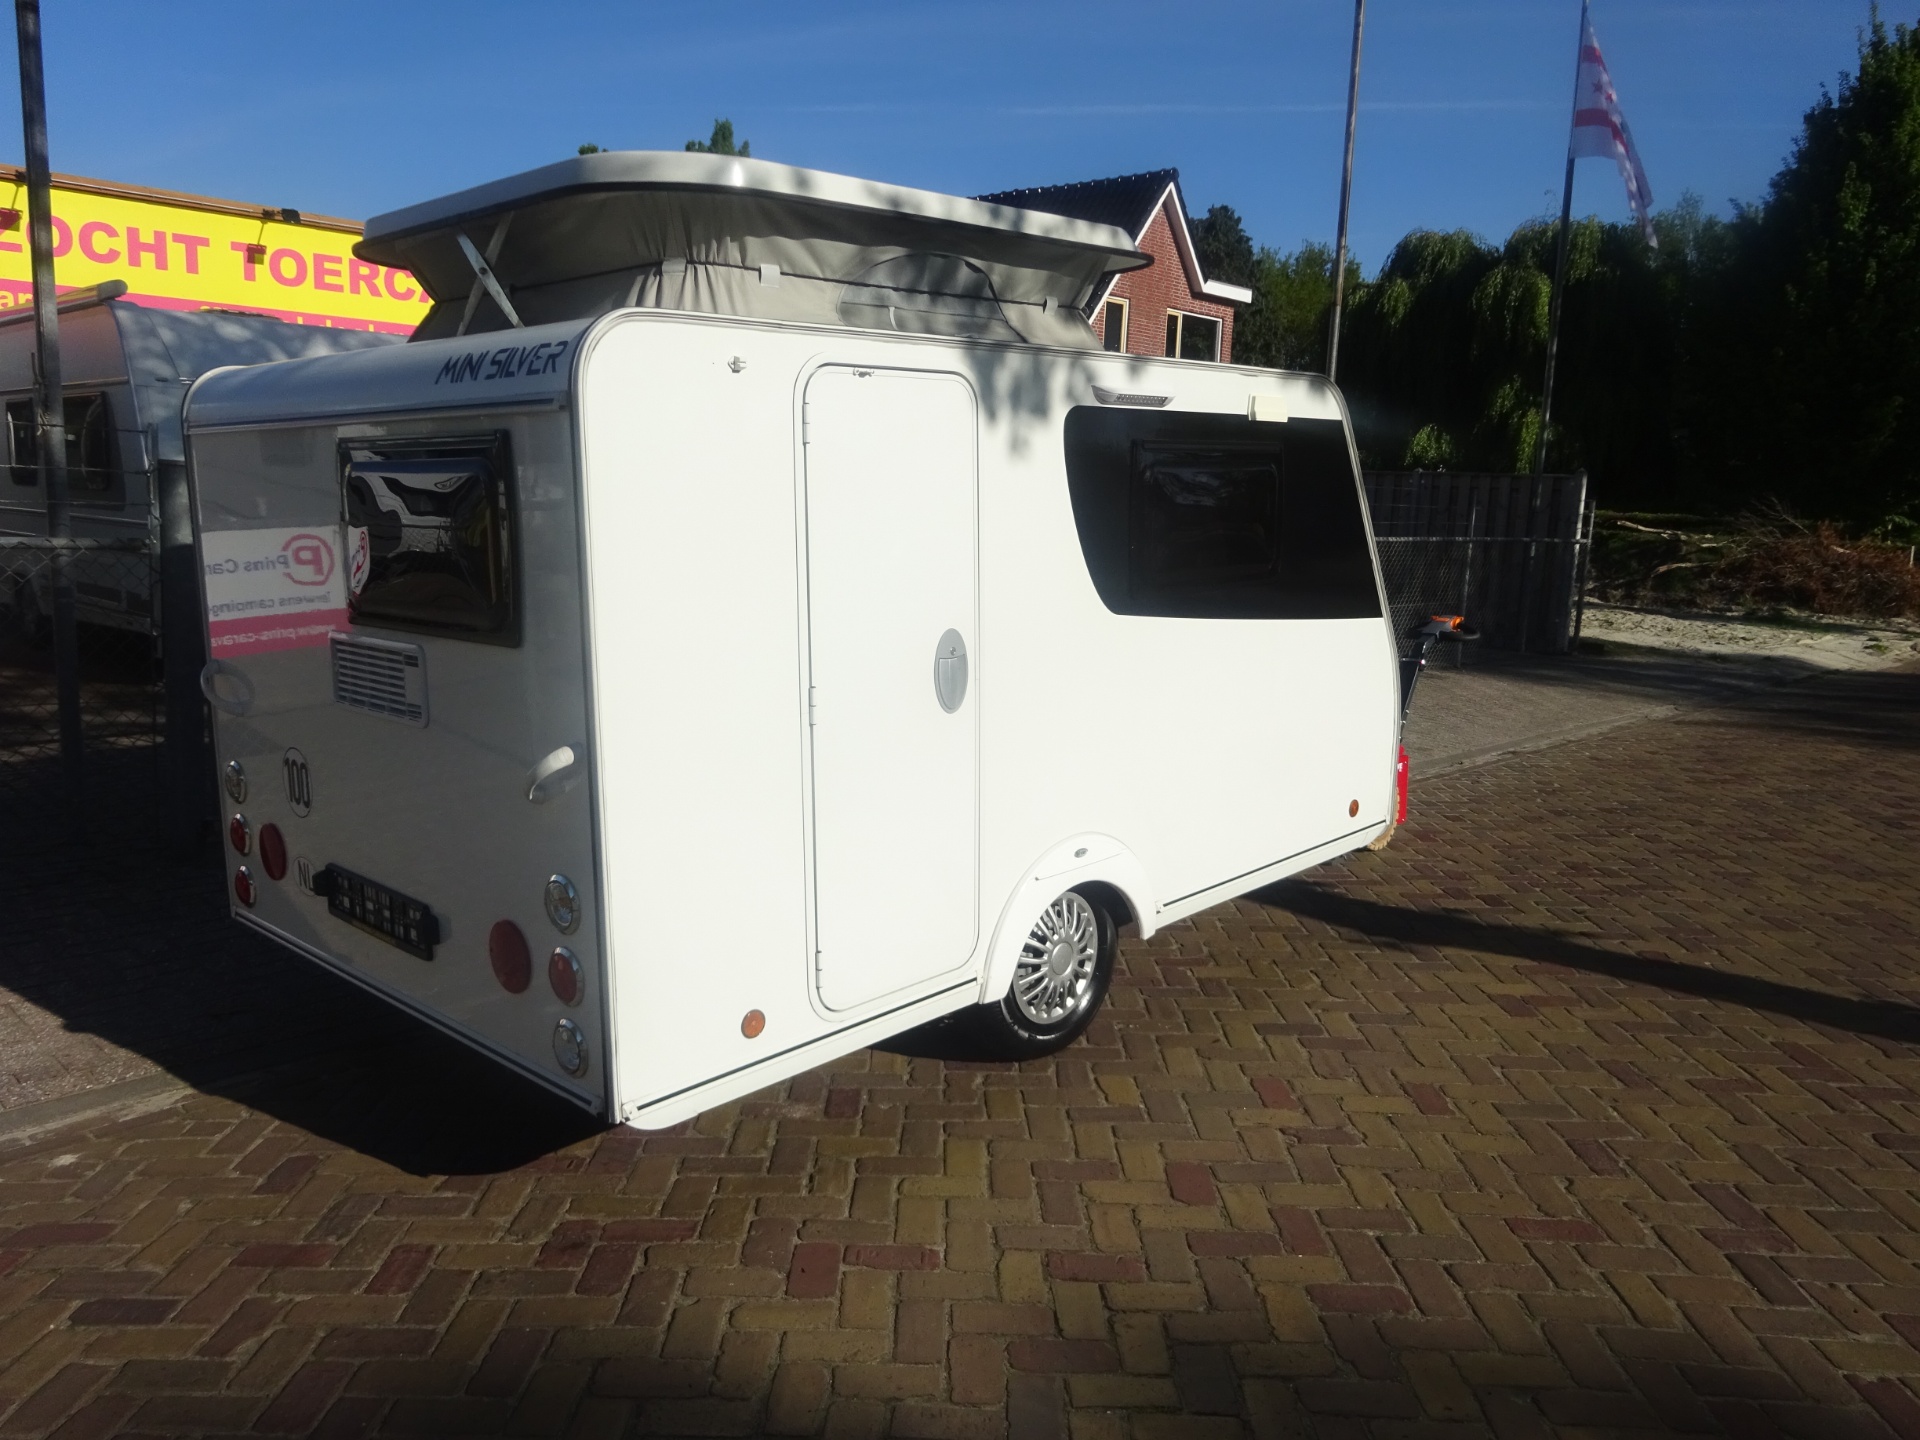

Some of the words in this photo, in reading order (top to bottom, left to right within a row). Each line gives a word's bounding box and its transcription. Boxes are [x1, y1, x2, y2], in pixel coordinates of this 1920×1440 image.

[230, 240, 430, 304] TOERC
[434, 350, 490, 385] MINI
[484, 340, 569, 381] SILVER
[284, 757, 311, 809] 100
[297, 859, 314, 892] NL
